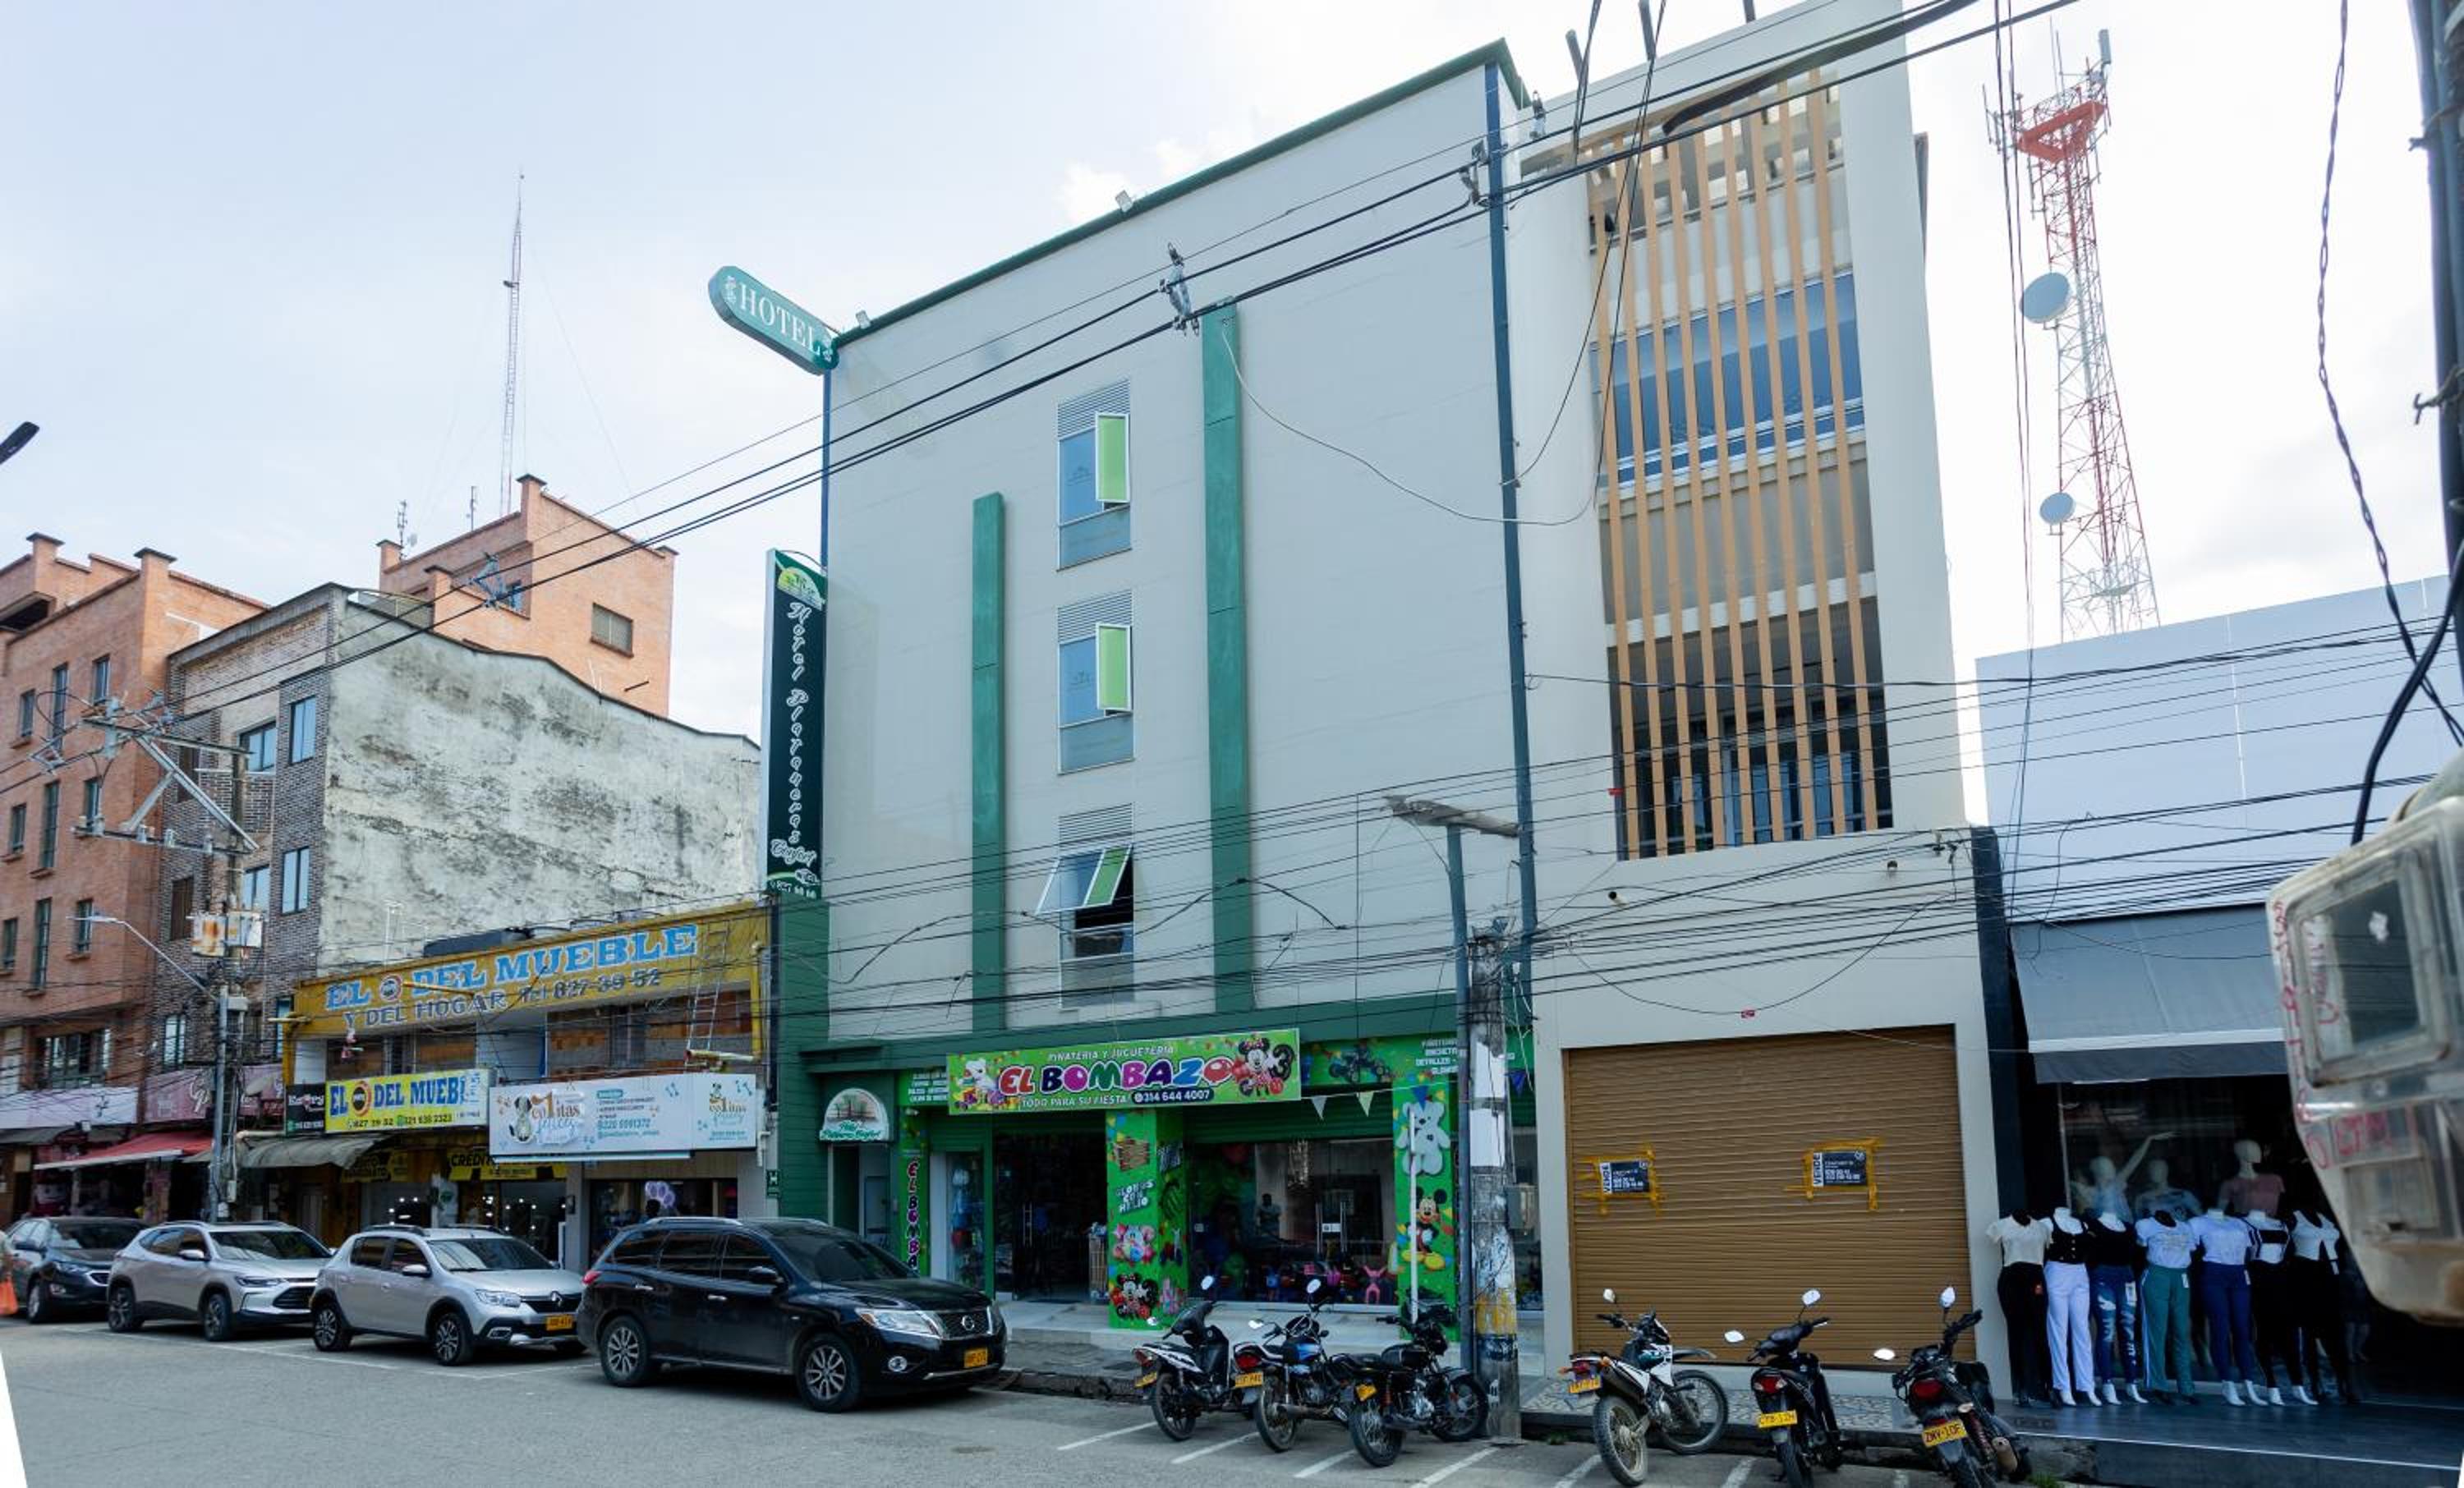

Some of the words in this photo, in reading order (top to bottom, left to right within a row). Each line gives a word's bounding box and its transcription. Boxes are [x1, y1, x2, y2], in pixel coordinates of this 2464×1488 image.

[739, 282, 821, 356] HOTEL
[325, 980, 371, 1011] EL
[413, 960, 486, 997] DEL
[494, 924, 698, 983] MUEBLE
[366, 1003, 407, 1026] DEL
[416, 990, 508, 1019] HOGAR
[999, 1065, 1037, 1095] EL
[1041, 1055, 1234, 1095] BOMBAZO
[329, 1085, 349, 1117] EL
[374, 1082, 404, 1109] DEL
[1161, 1091, 1182, 1102] 644
